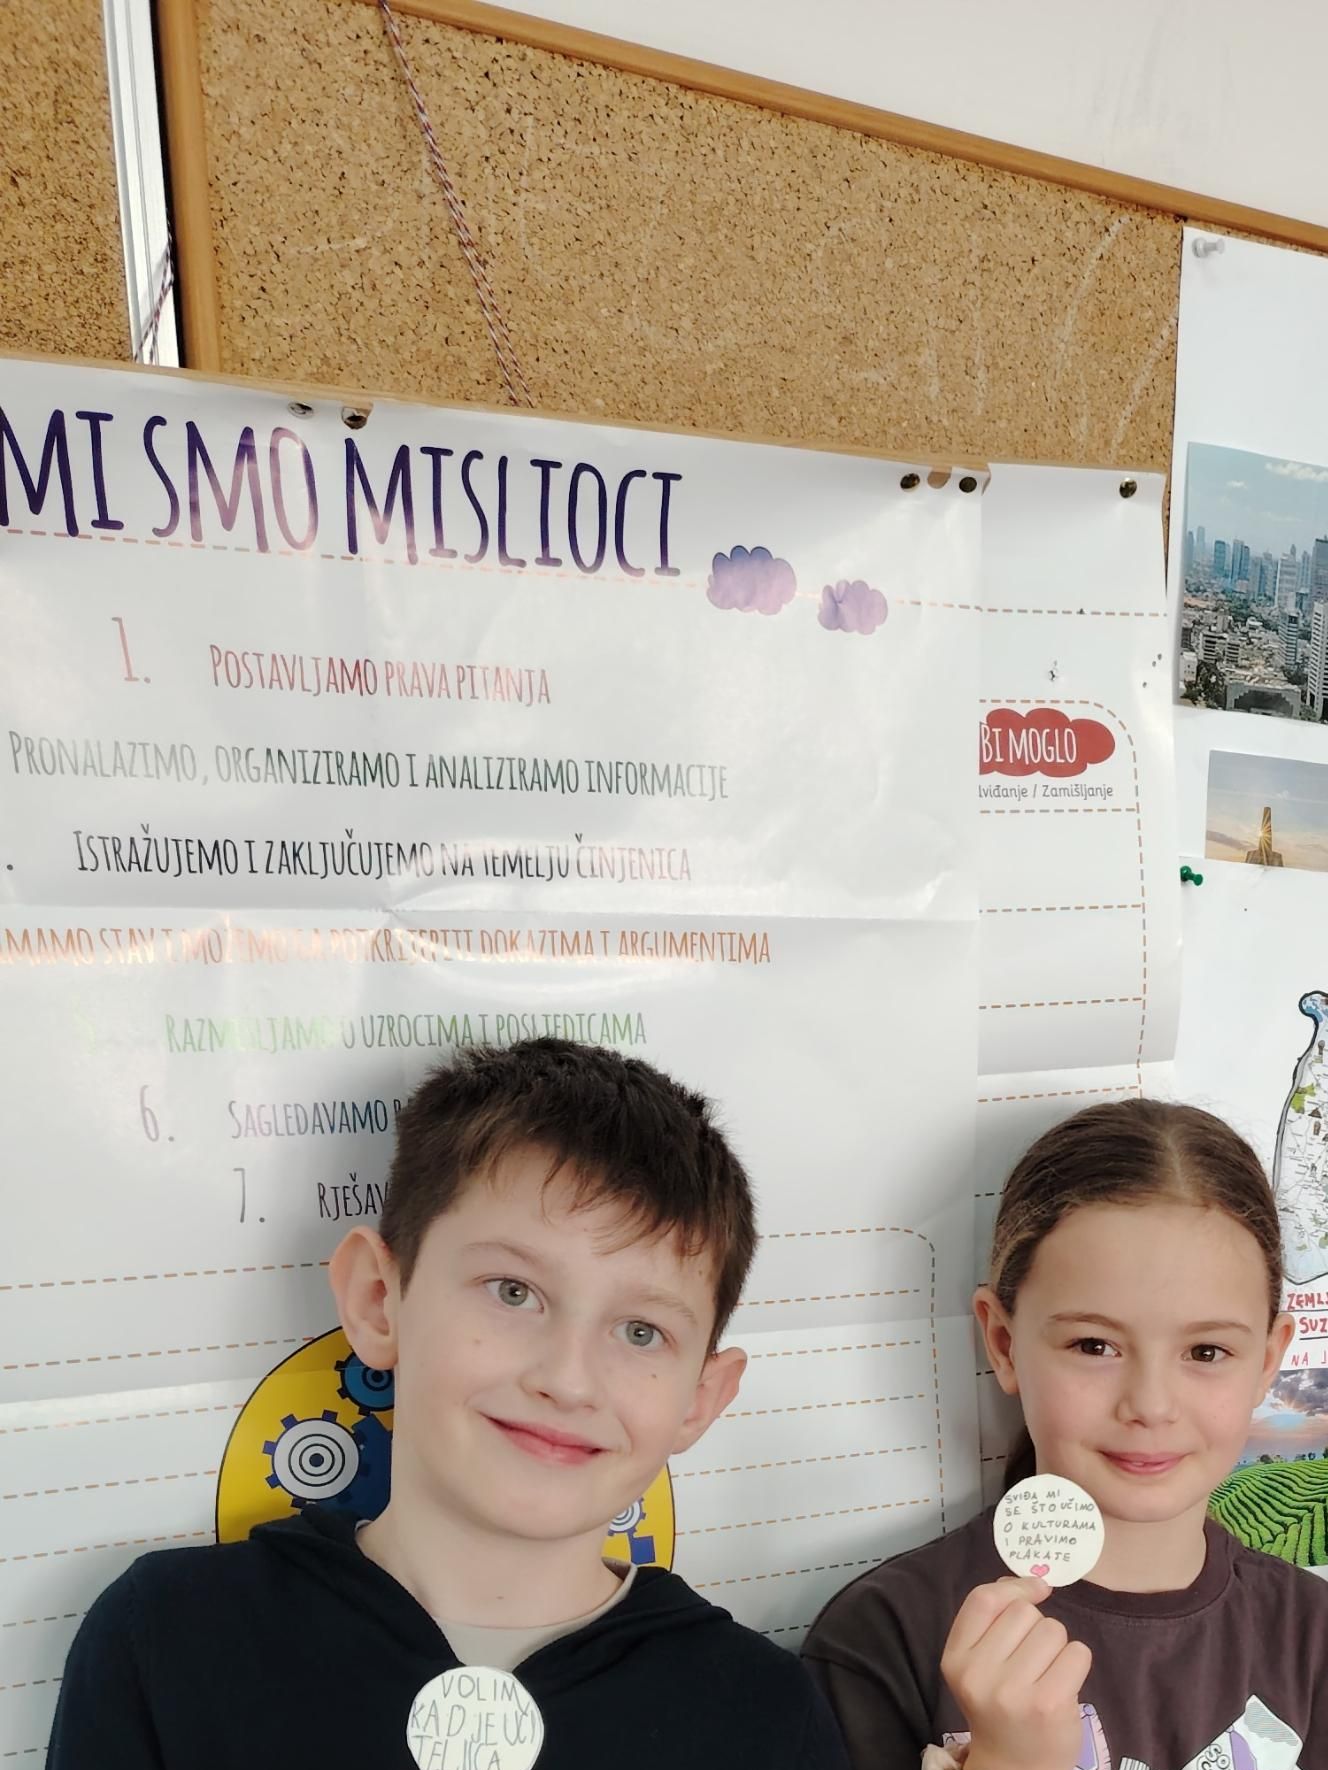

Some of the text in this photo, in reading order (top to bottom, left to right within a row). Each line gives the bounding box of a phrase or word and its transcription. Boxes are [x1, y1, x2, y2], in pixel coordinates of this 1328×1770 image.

[0, 407, 683, 576] MI SMO MISLIOCI
[111, 617, 152, 683] 1.
[385, 660, 453, 699] PRAVA
[456, 665, 551, 707] PITANJA
[1008, 728, 1077, 765] MOGLO
[214, 744, 401, 789] ORGANIZIRAMO
[406, 752, 420, 788] I
[425, 754, 581, 795] ANALIZIRAMO
[585, 757, 730, 800] INFORMACIJE
[1042, 784, 1113, 801] Zamišljanje
[73, 823, 692, 883] ISTRAŽUJEMO I ZAKLJUČUJEMO NA TEMELJU ČINJENICA
[617, 930, 771, 965] ARGUMENTIMA
[361, 1014, 474, 1048] UZROCIMA
[139, 1084, 175, 1143] 6.
[228, 1099, 389, 1139] SAGLEDAVAMO
[317, 1172, 388, 1222] RJEŠAV
[1291, 1353, 1309, 1367] NA
[1005, 1498, 1095, 1517] SE ŠTO UČIMO
[1046, 1489, 1060, 1499] MI
[1003, 1520, 1096, 1533] O KULTURAMA
[1018, 1534, 1077, 1546] PRAVIMO
[441, 1674, 523, 1707] VOLIM
[410, 1699, 467, 1737] KAD
[471, 1711, 499, 1746] JE
